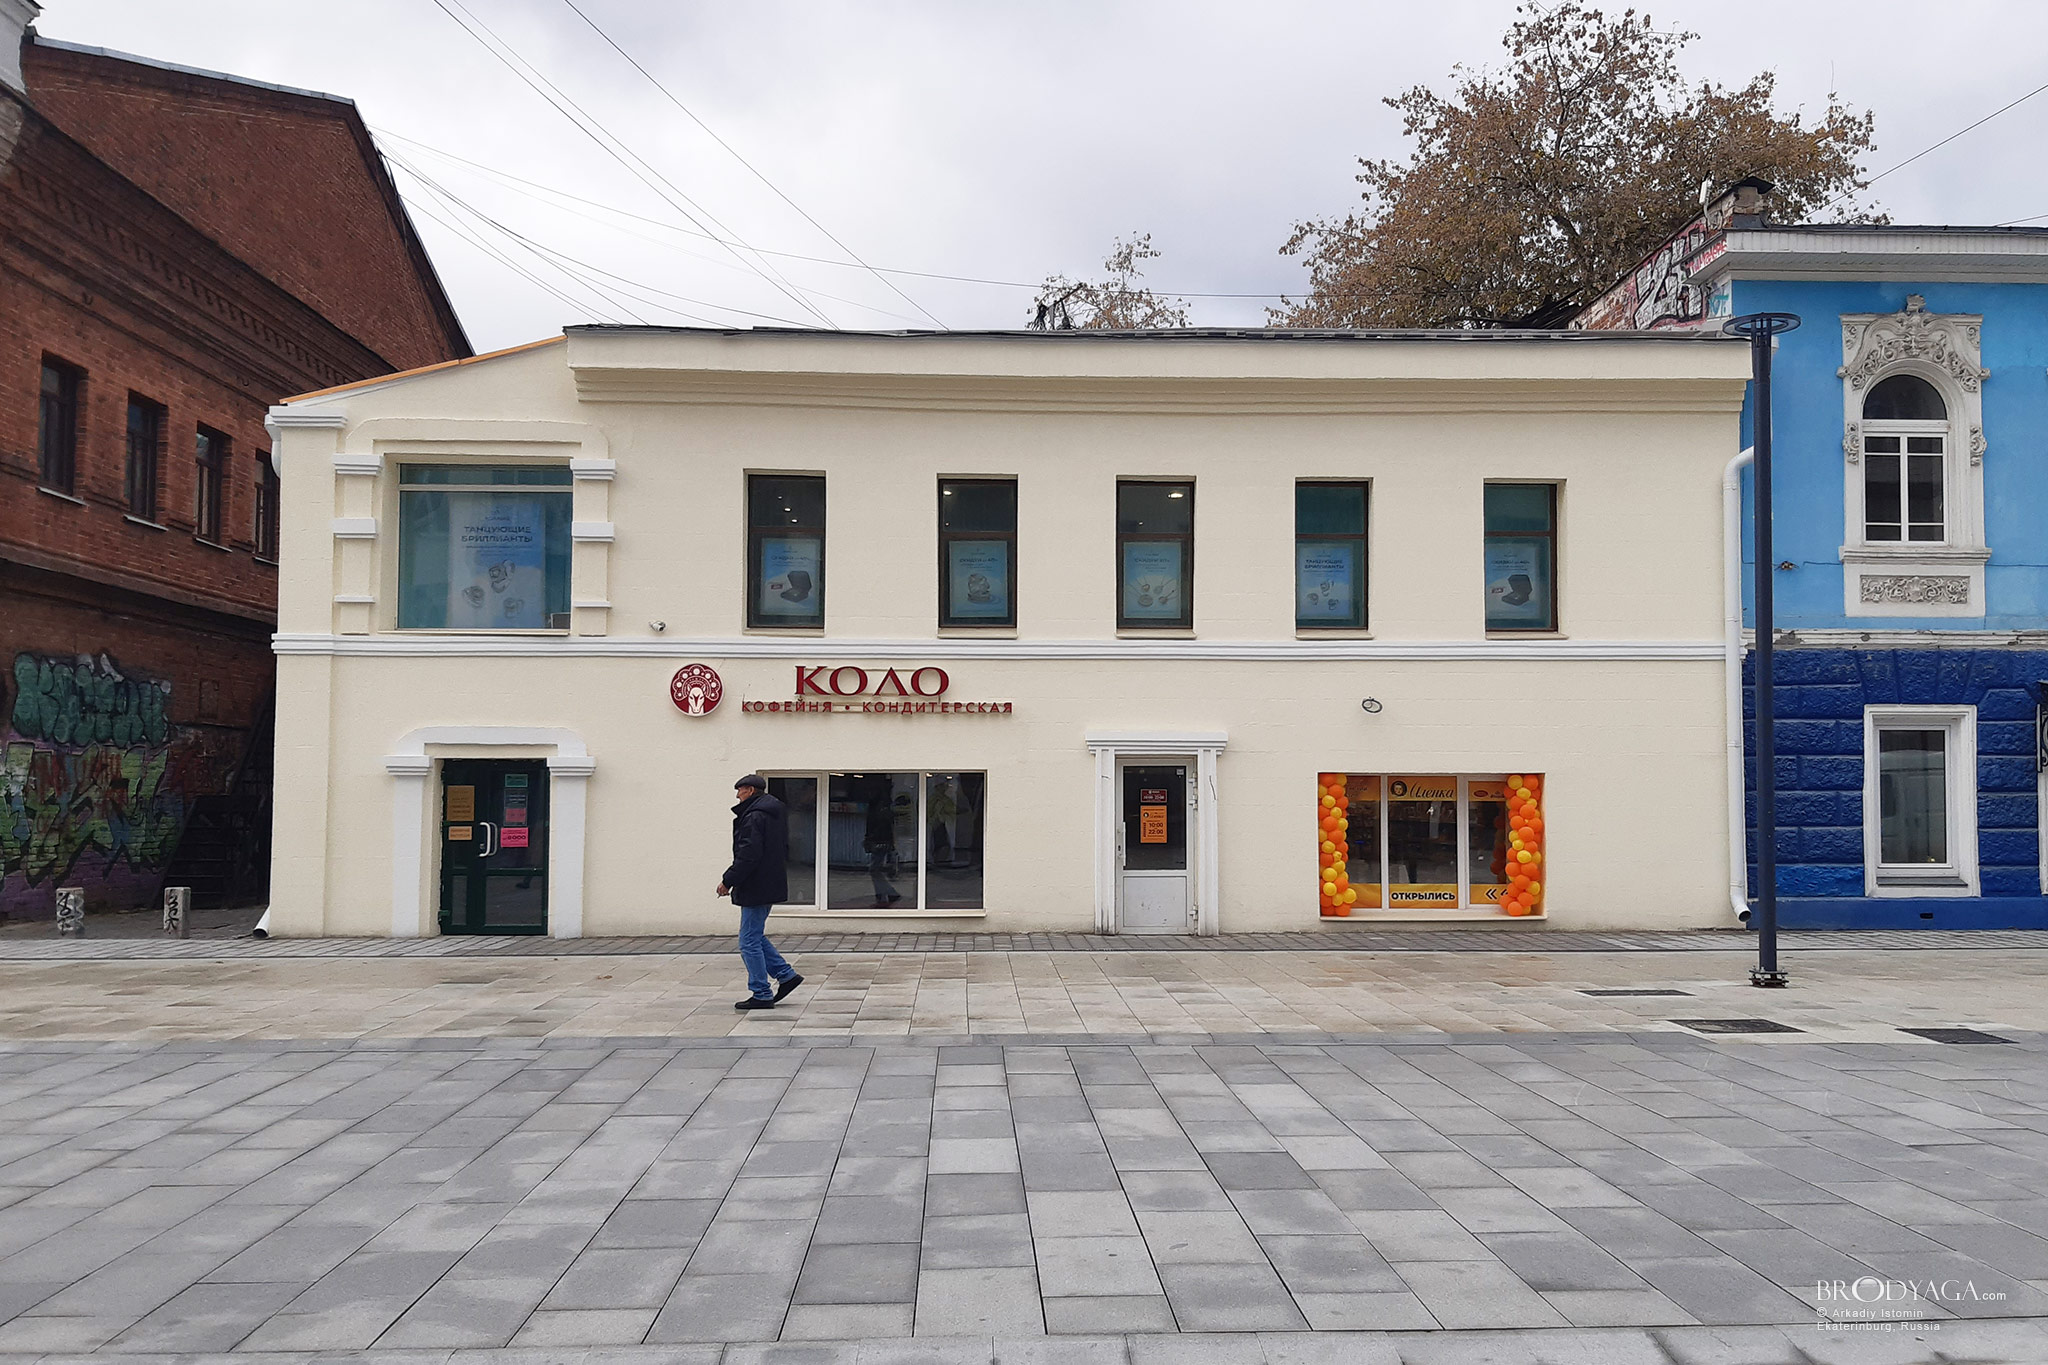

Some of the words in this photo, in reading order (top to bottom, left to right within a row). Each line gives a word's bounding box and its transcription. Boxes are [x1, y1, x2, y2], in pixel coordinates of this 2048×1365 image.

[464, 526, 532, 534] ТАНЦУЮЩИЕ
[461, 535, 533, 543] БРИЛЛИАНТЫ
[794, 665, 951, 697] КОЛО
[742, 699, 832, 713] КОФЕЙНЯ
[862, 700, 1013, 715] КОНДИТЕРСКАЯ
[1391, 891, 1456, 901] ОТКРЫЛИСЬ
